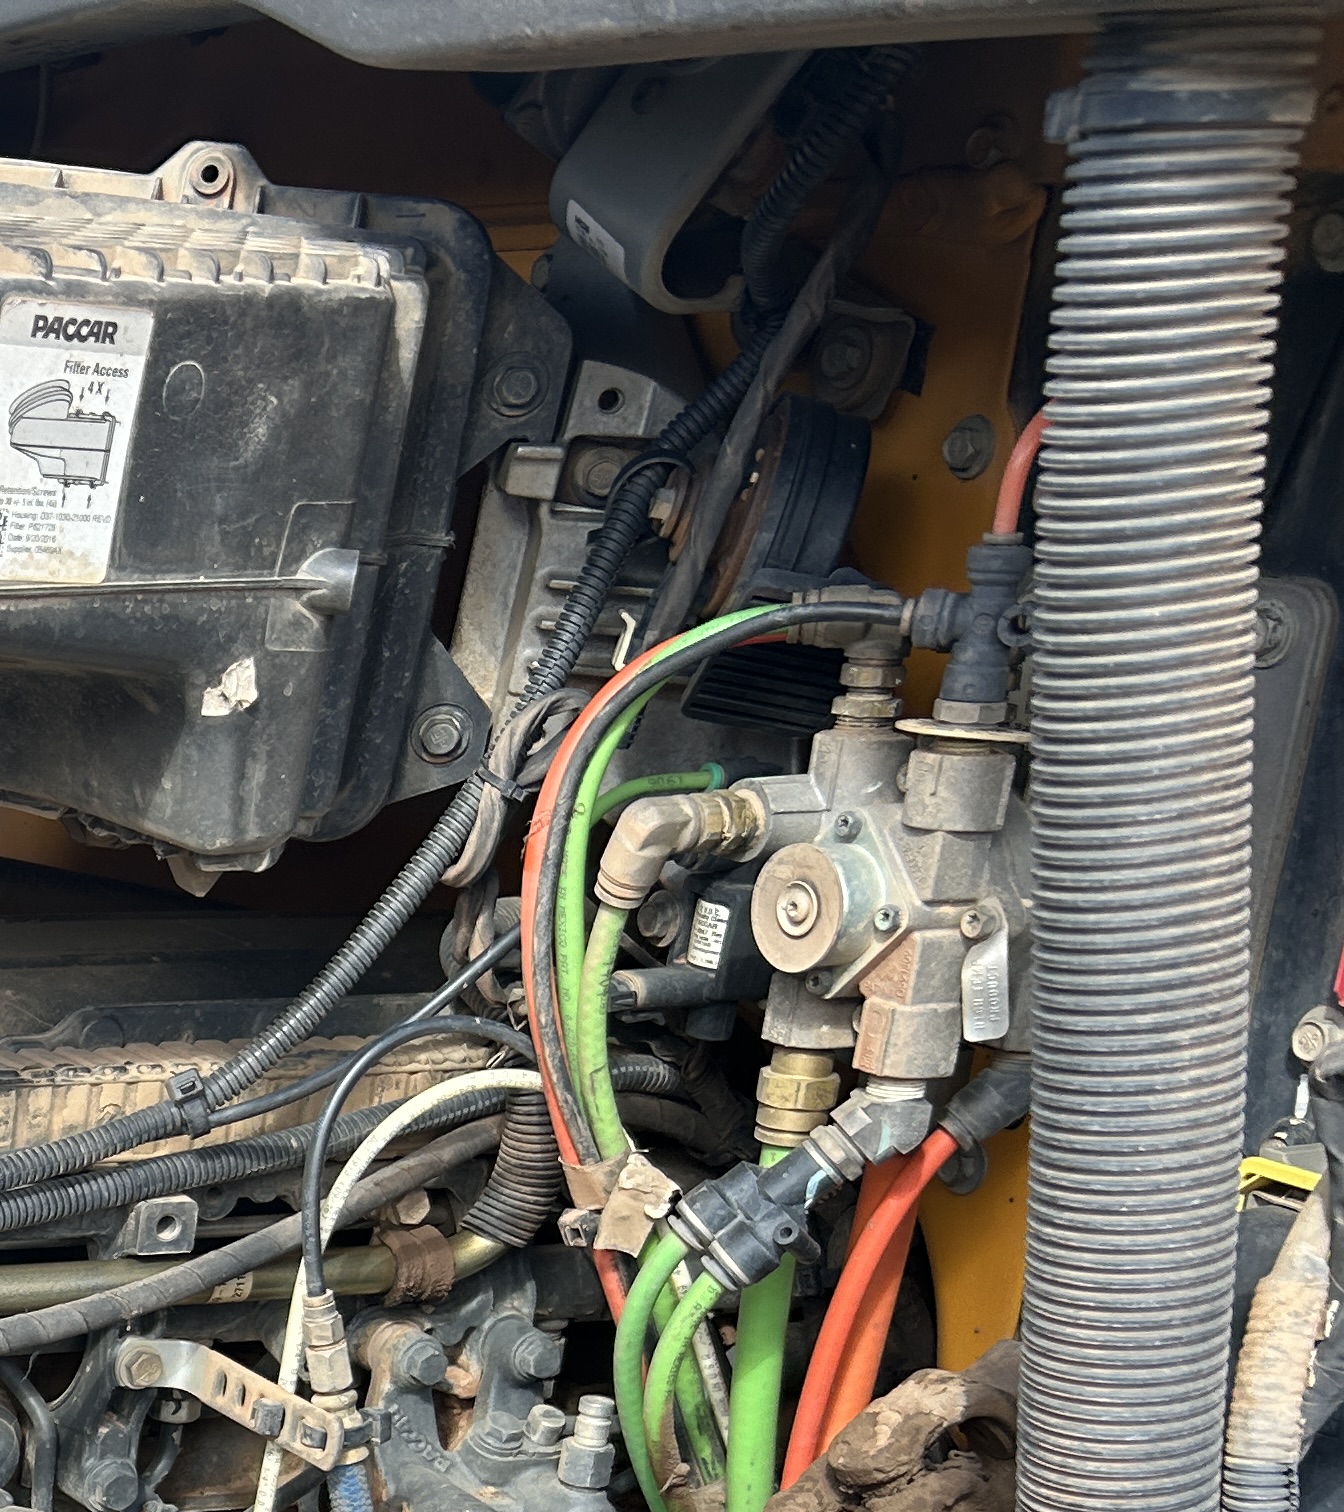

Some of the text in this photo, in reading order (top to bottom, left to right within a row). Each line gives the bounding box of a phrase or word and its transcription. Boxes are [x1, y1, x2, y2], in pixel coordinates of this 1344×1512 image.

[31, 314, 118, 345] PACCAR
[63, 360, 130, 379] Filter Access
